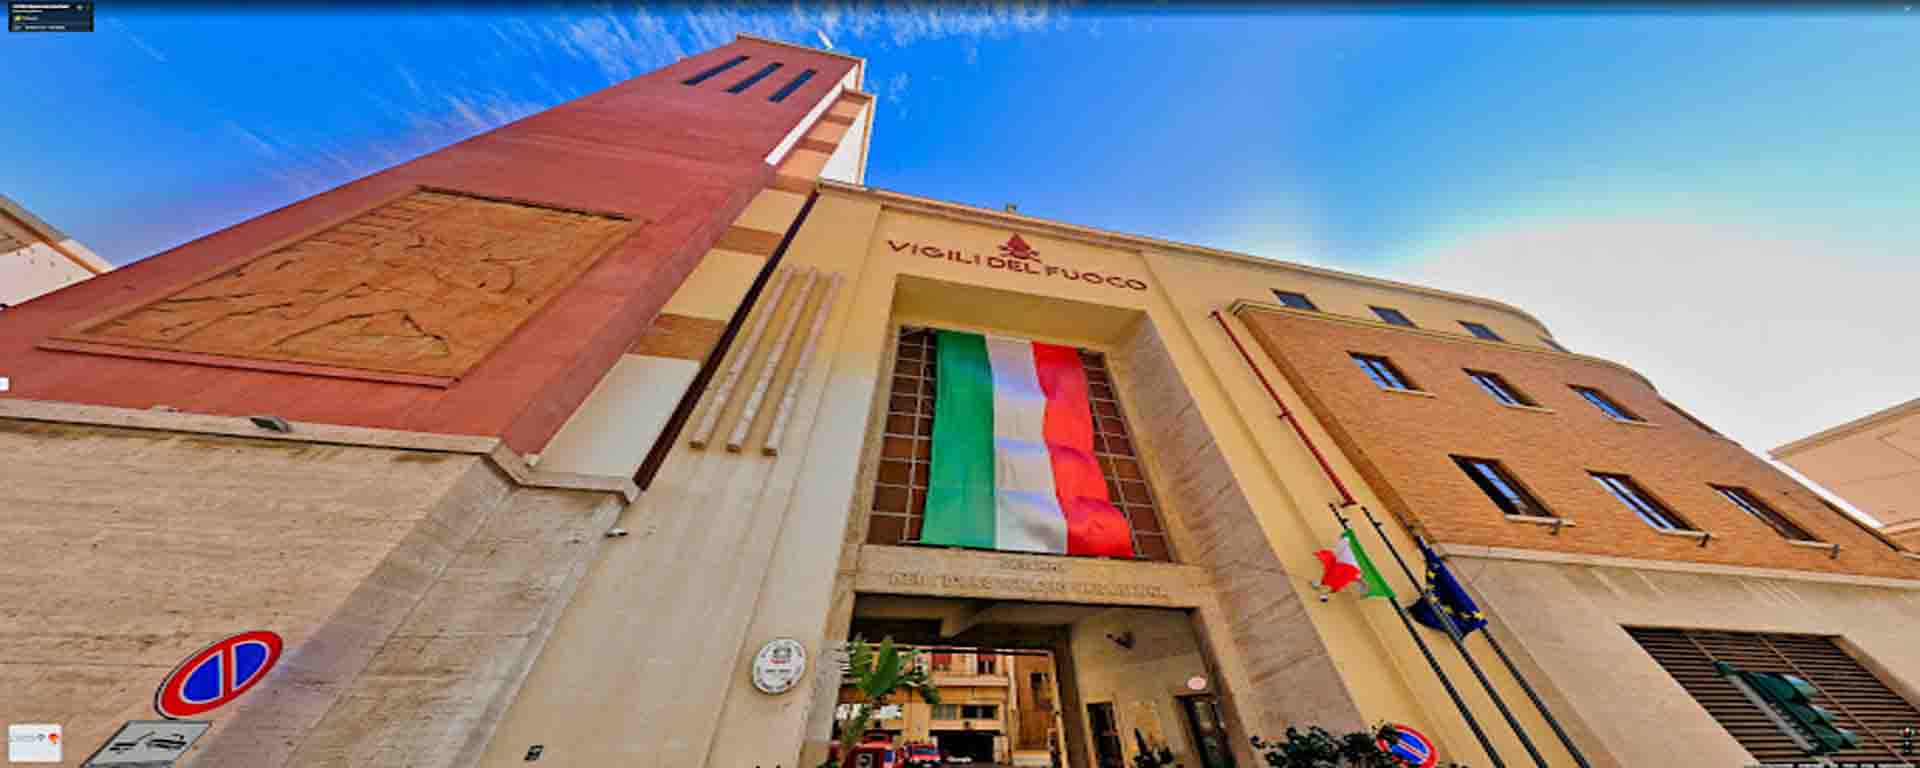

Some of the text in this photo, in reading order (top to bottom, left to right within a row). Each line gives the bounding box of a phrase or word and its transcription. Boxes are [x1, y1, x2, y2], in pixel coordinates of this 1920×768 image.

[887, 240, 1147, 290] VIGILI DEL FUOCO
